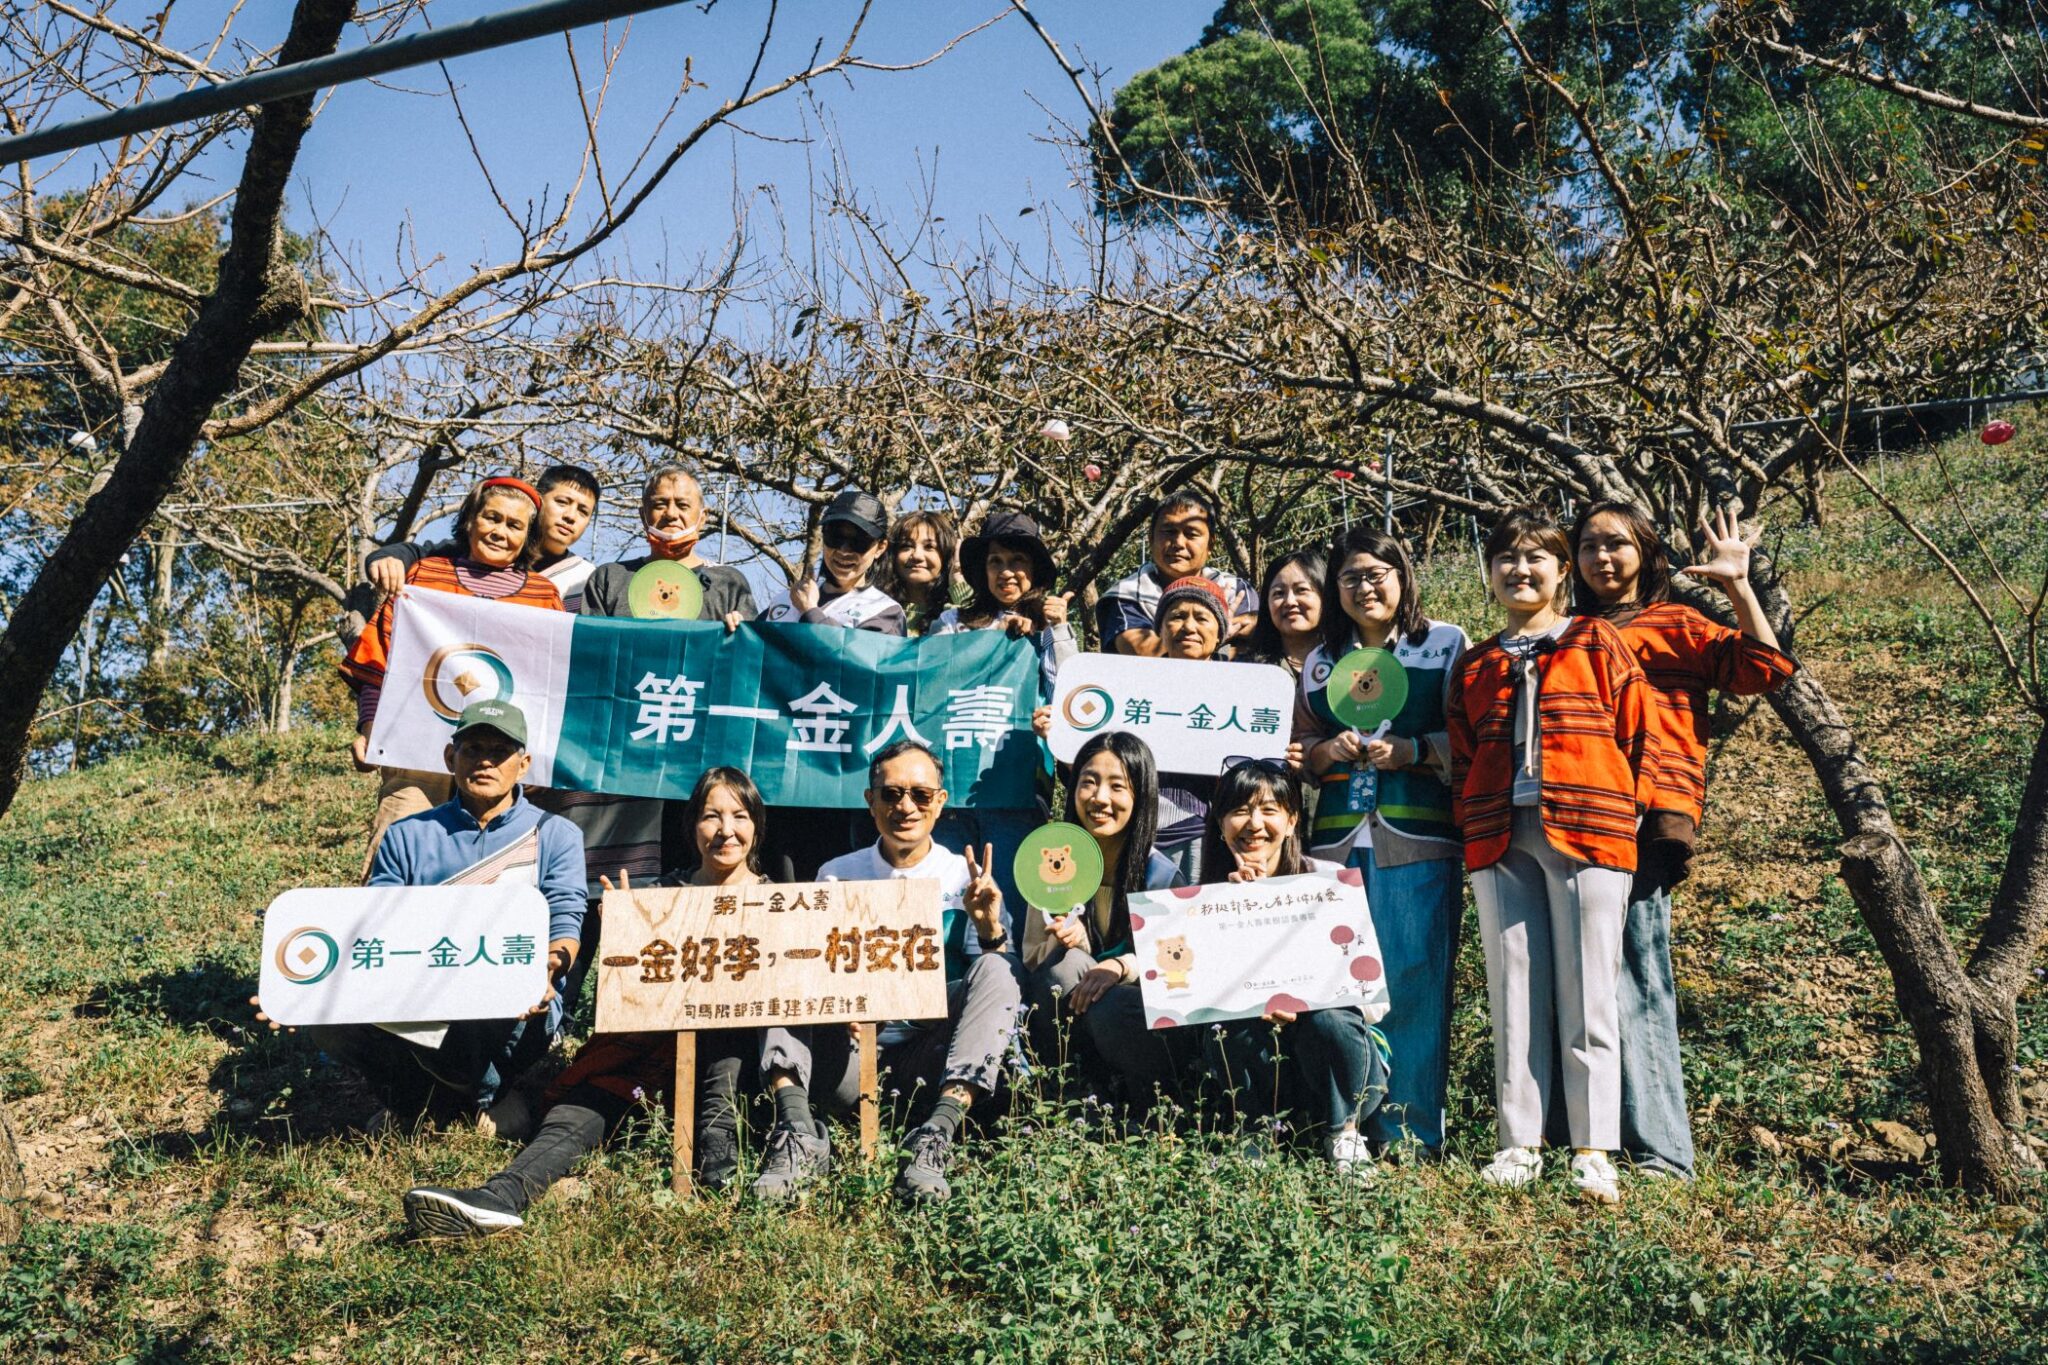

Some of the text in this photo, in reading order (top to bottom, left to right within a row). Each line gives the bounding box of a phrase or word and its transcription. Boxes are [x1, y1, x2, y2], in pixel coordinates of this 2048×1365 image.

[630, 672, 1015, 752] 第一金人壽
[1122, 698, 1281, 736] 第一金人壽
[713, 889, 830, 916] 第一金人壽
[352, 934, 535, 970] 第一金人壽
[602, 924, 940, 984] 一金好李，一村安在
